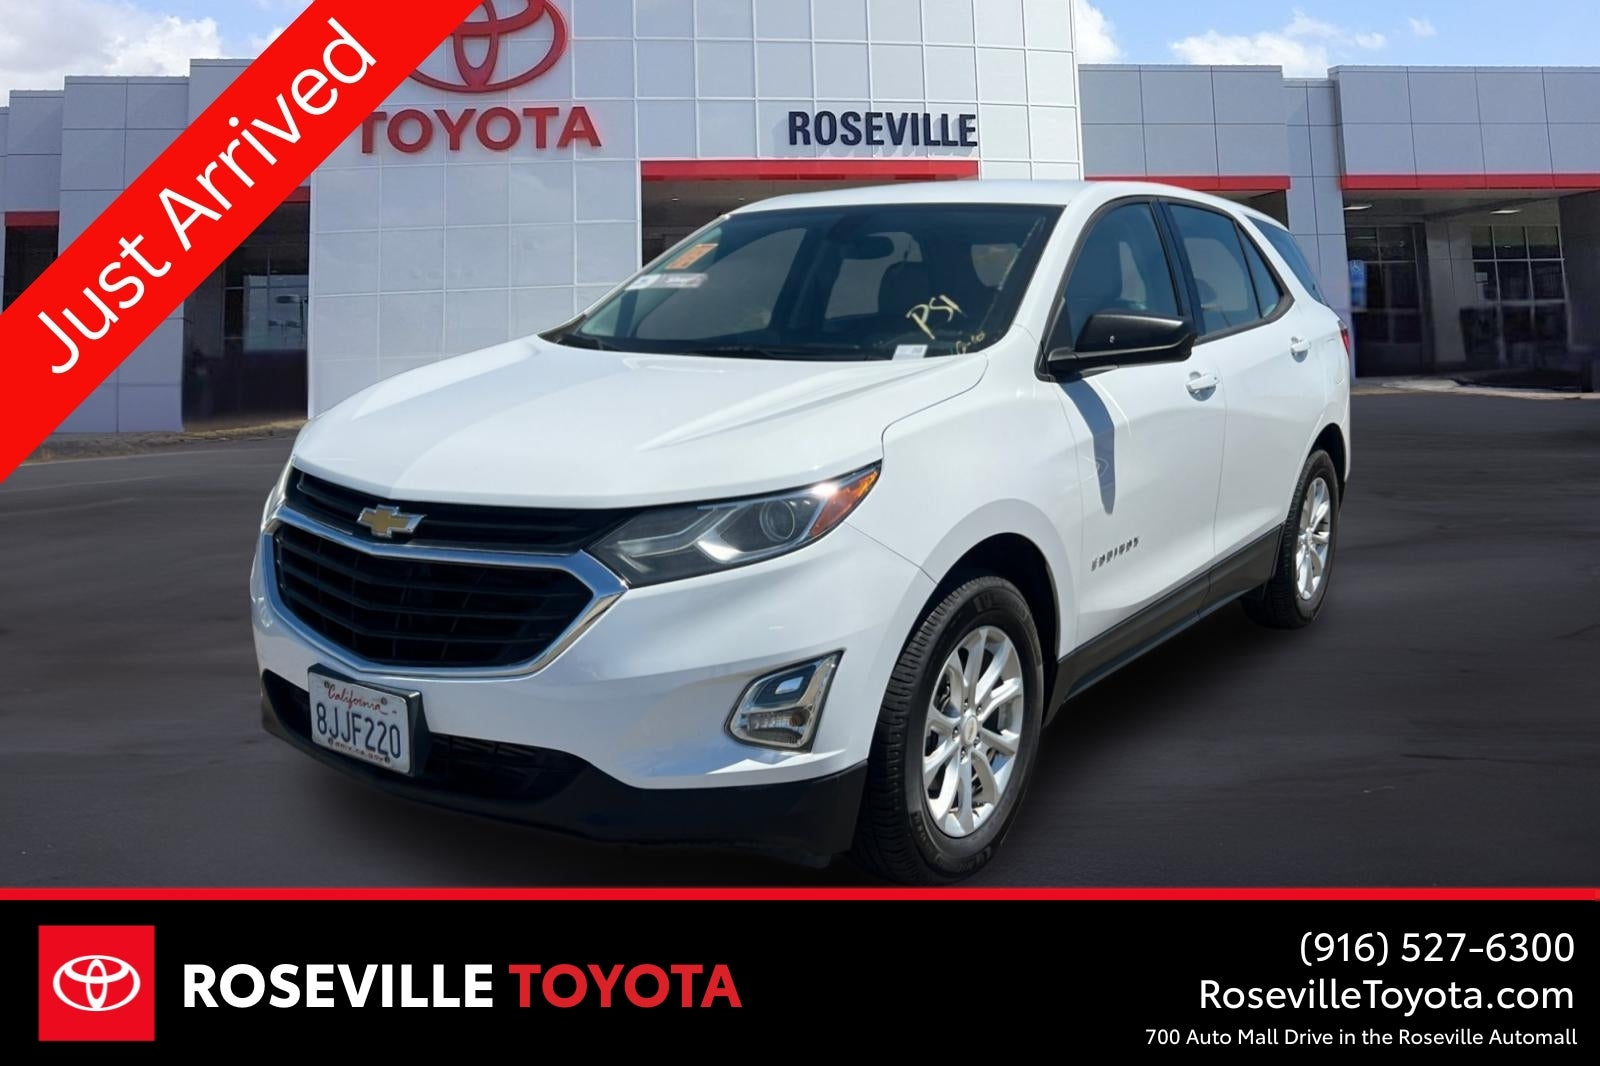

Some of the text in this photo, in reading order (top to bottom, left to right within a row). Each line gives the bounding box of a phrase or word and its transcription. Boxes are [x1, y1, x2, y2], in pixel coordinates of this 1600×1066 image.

[361, 106, 602, 154] TOYOTA
[788, 110, 978, 147] ROSEVILLE
[328, 684, 389, 716] California
[316, 702, 401, 759] 8JJF220
